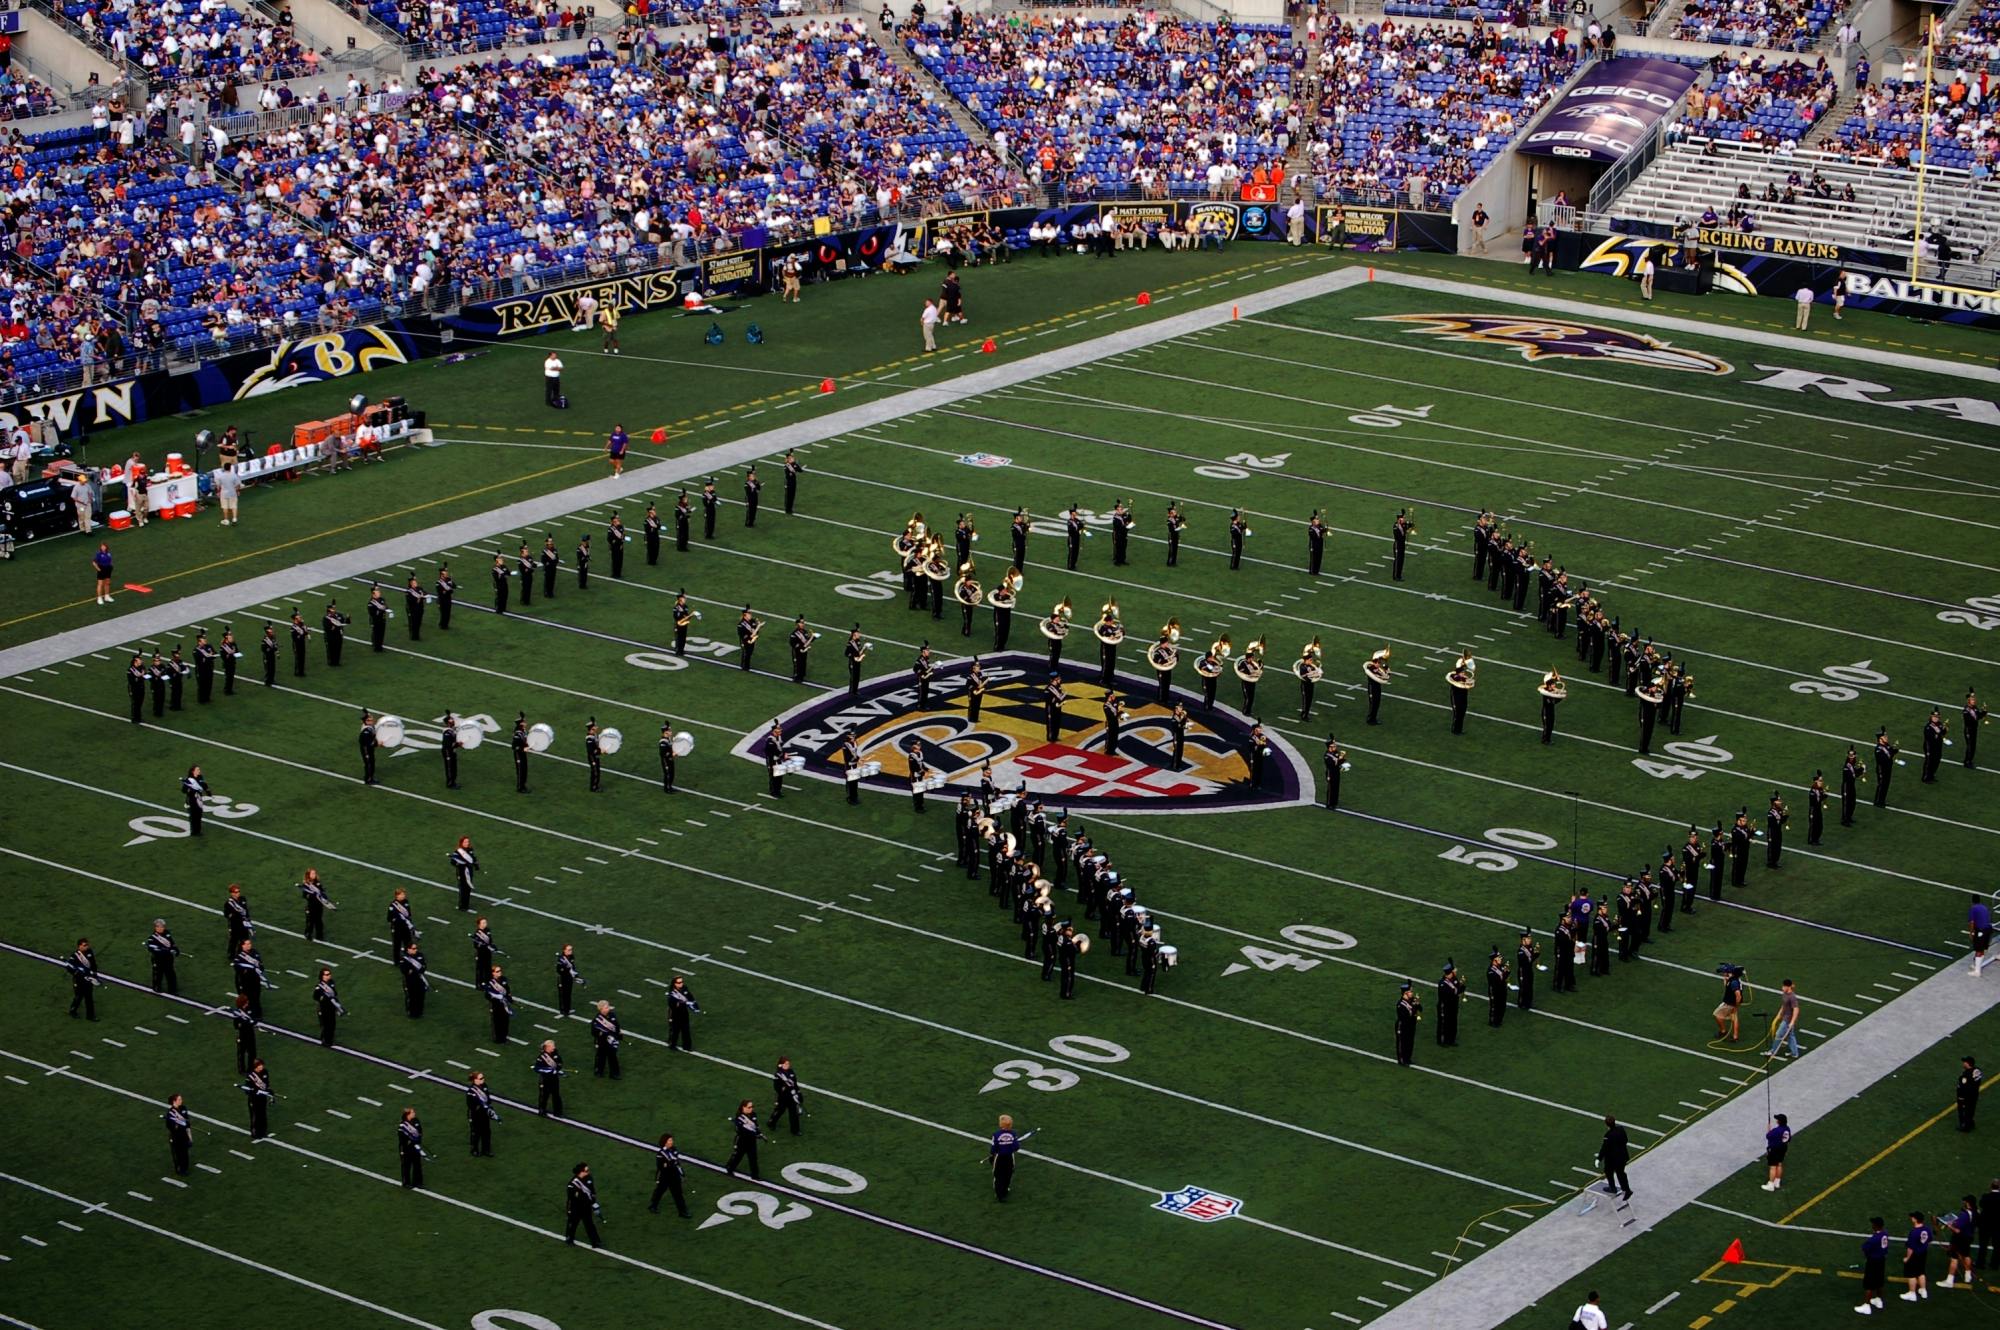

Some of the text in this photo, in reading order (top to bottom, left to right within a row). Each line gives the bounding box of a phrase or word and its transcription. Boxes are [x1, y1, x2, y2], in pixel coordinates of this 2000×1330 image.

[1569, 85, 1675, 109] GEICO
[1527, 130, 1632, 154] GEICO
[1552, 146, 1592, 158] GEICO
[1139, 208, 1164, 216] STOVER
[1195, 206, 1234, 214] RAVENS
[1327, 222, 1386, 236] FNDATION
[1773, 237, 1839, 260] RAVENS
[709, 267, 753, 284] FOUNDATION
[493, 269, 678, 336] RAVENS
[0, 380, 137, 434] WN
[1348, 404, 1431, 427] 10
[1193, 453, 1285, 479] 20
[1790, 665, 1889, 701] 30
[783, 666, 1027, 752] RAVENS
[1632, 741, 1735, 780] 40
[128, 795, 260, 838] 30
[1437, 827, 1558, 871] 50
[1240, 924, 1358, 971] 40
[992, 1034, 1131, 1092] 30
[716, 1161, 869, 1230] 20
